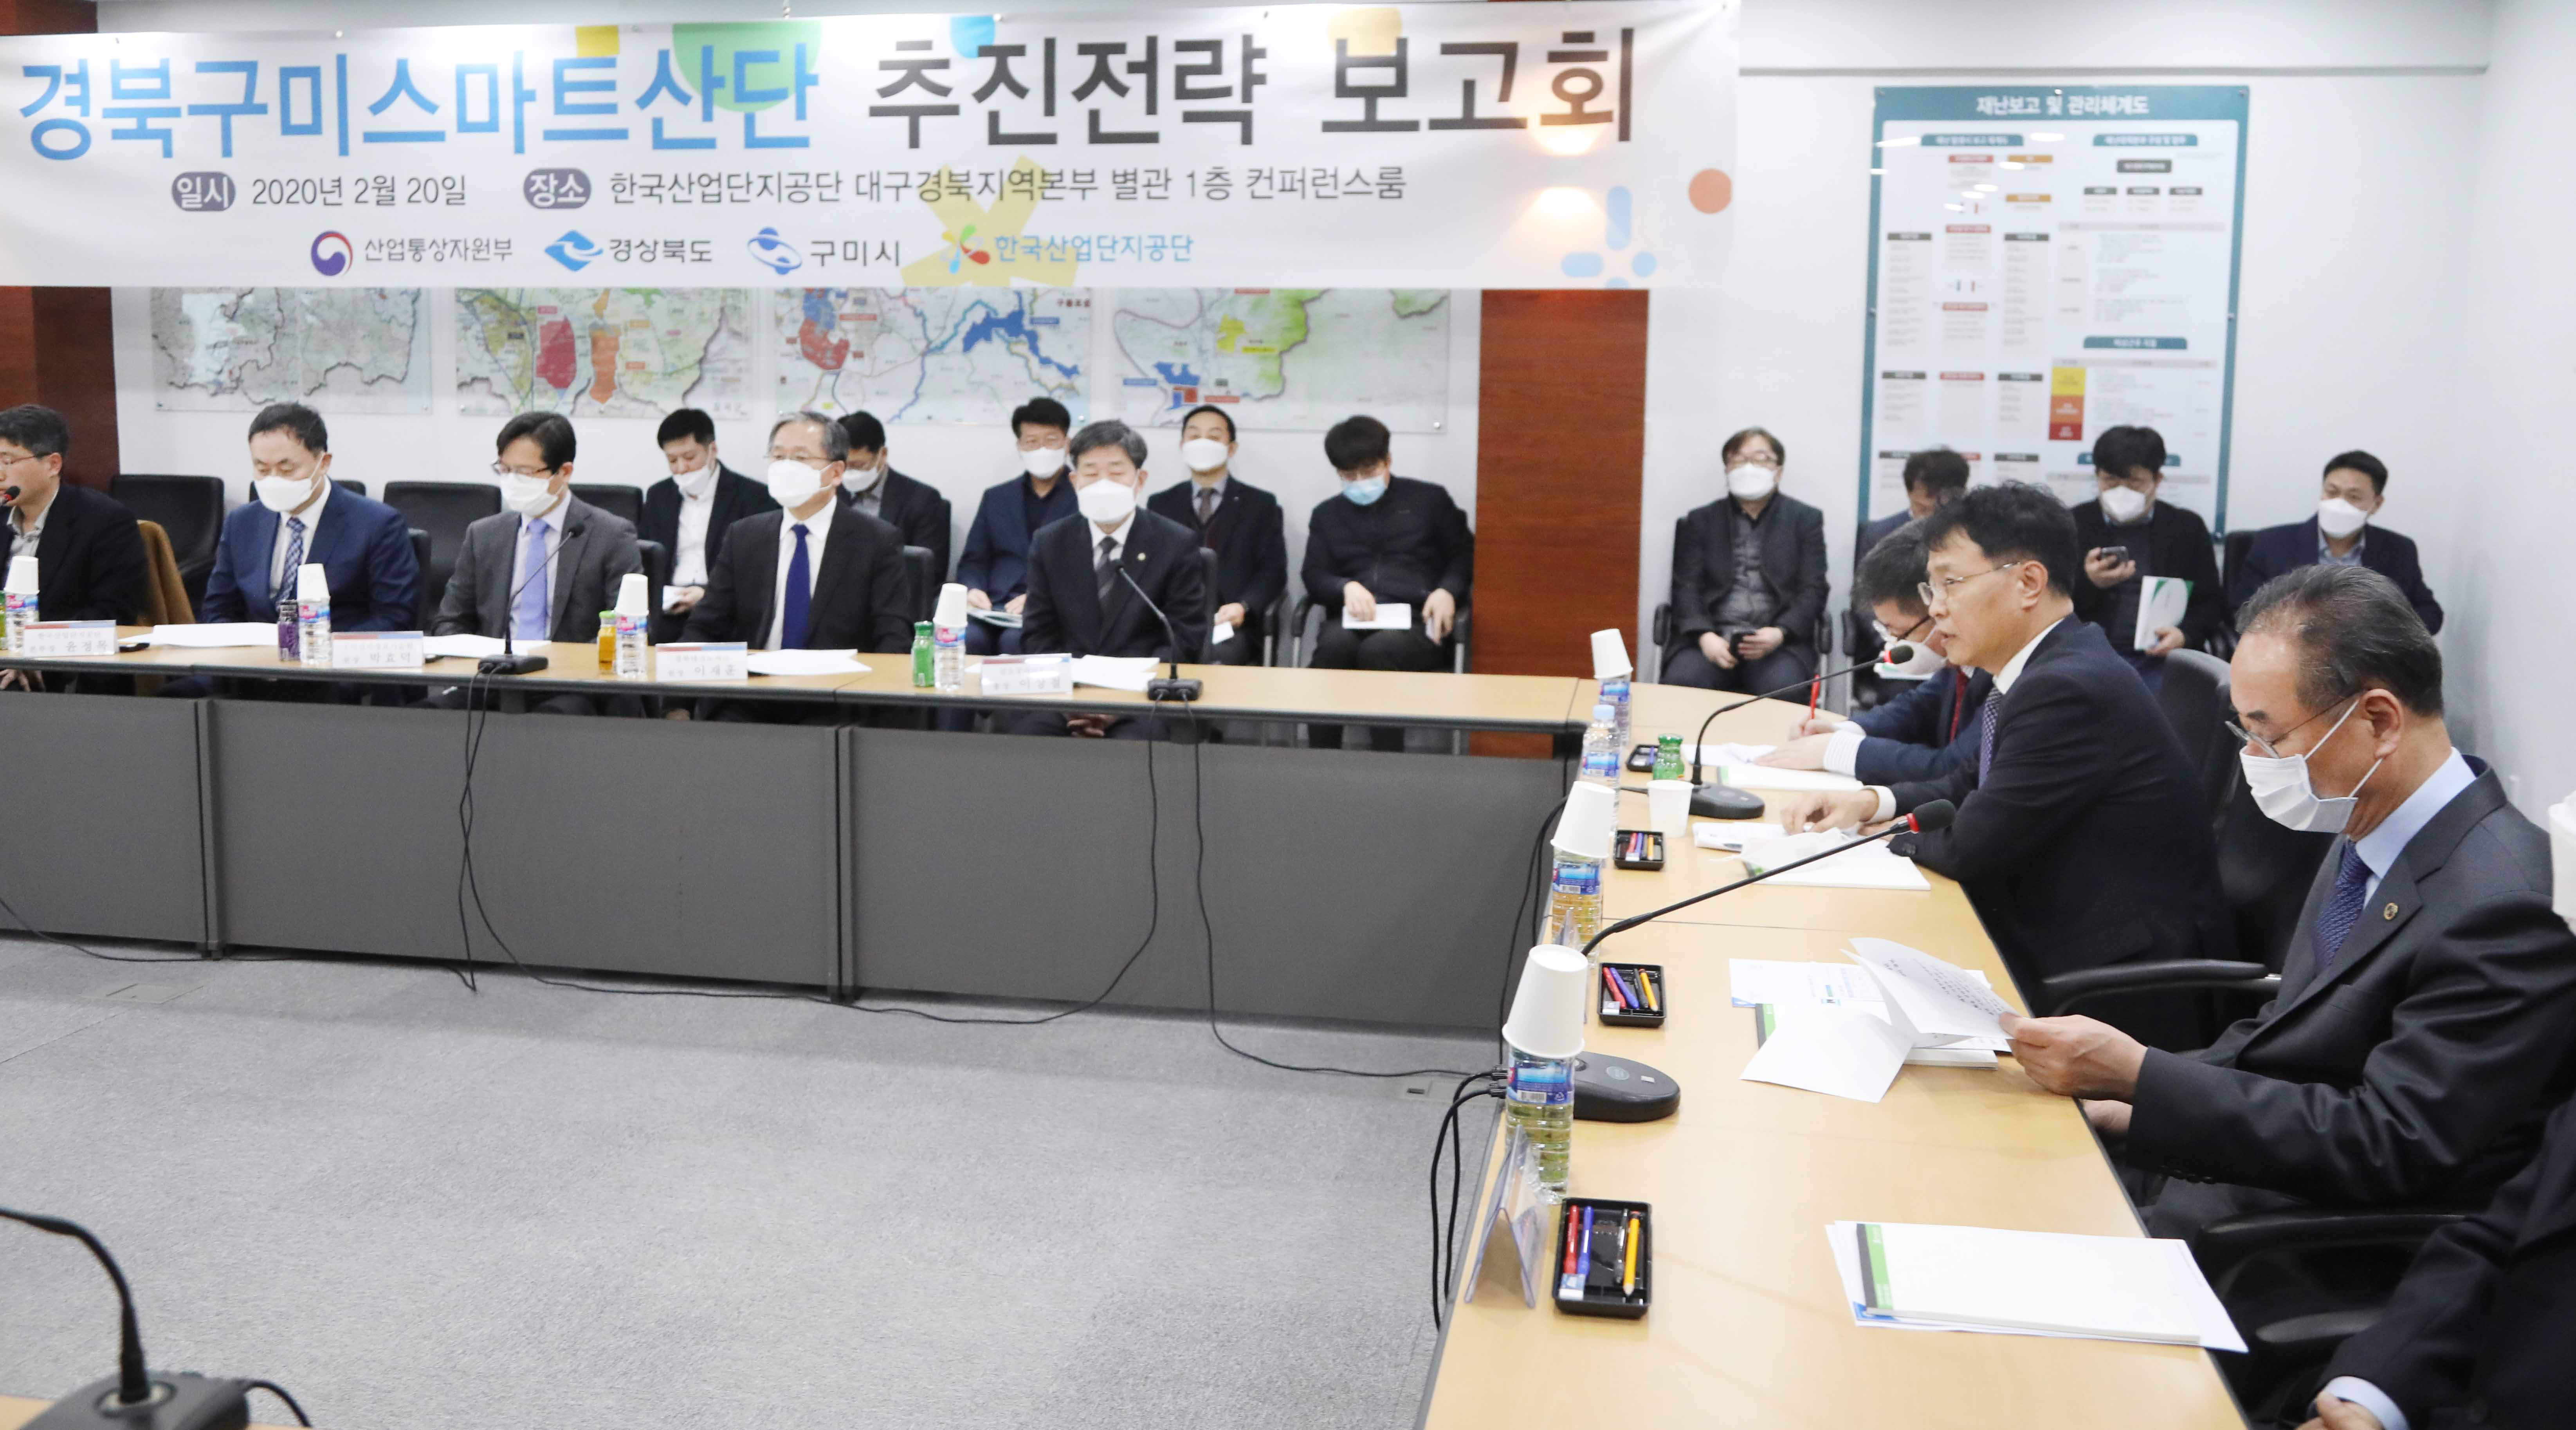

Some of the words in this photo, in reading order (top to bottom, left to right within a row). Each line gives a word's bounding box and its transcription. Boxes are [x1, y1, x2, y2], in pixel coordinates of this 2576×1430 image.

[21, 43, 819, 160] 경북구미스마트산단
[869, 35, 1266, 149] 추진전략
[1321, 27, 1635, 142] 보고회
[1976, 96, 2041, 115] 재난보고
[2046, 96, 2062, 115] 및
[2068, 95, 2149, 115] 관리체계도
[177, 177, 230, 208] 일시
[252, 177, 343, 206] 2020년
[354, 175, 395, 206] 2월
[407, 176, 465, 206] 20일
[530, 174, 589, 206] 장소
[611, 172, 842, 204] 한국산업단지공단
[855, 168, 1099, 204] 대구경북지역본부
[1112, 168, 1172, 200] 별관
[1186, 166, 1233, 201] 1층
[1247, 166, 1406, 200] 컨퍼런스룸
[365, 238, 512, 263] 산업통상자원부
[610, 239, 712, 263] 경상북도
[811, 240, 900, 267] 구미시
[996, 234, 1194, 262] 한국산업단지공단
